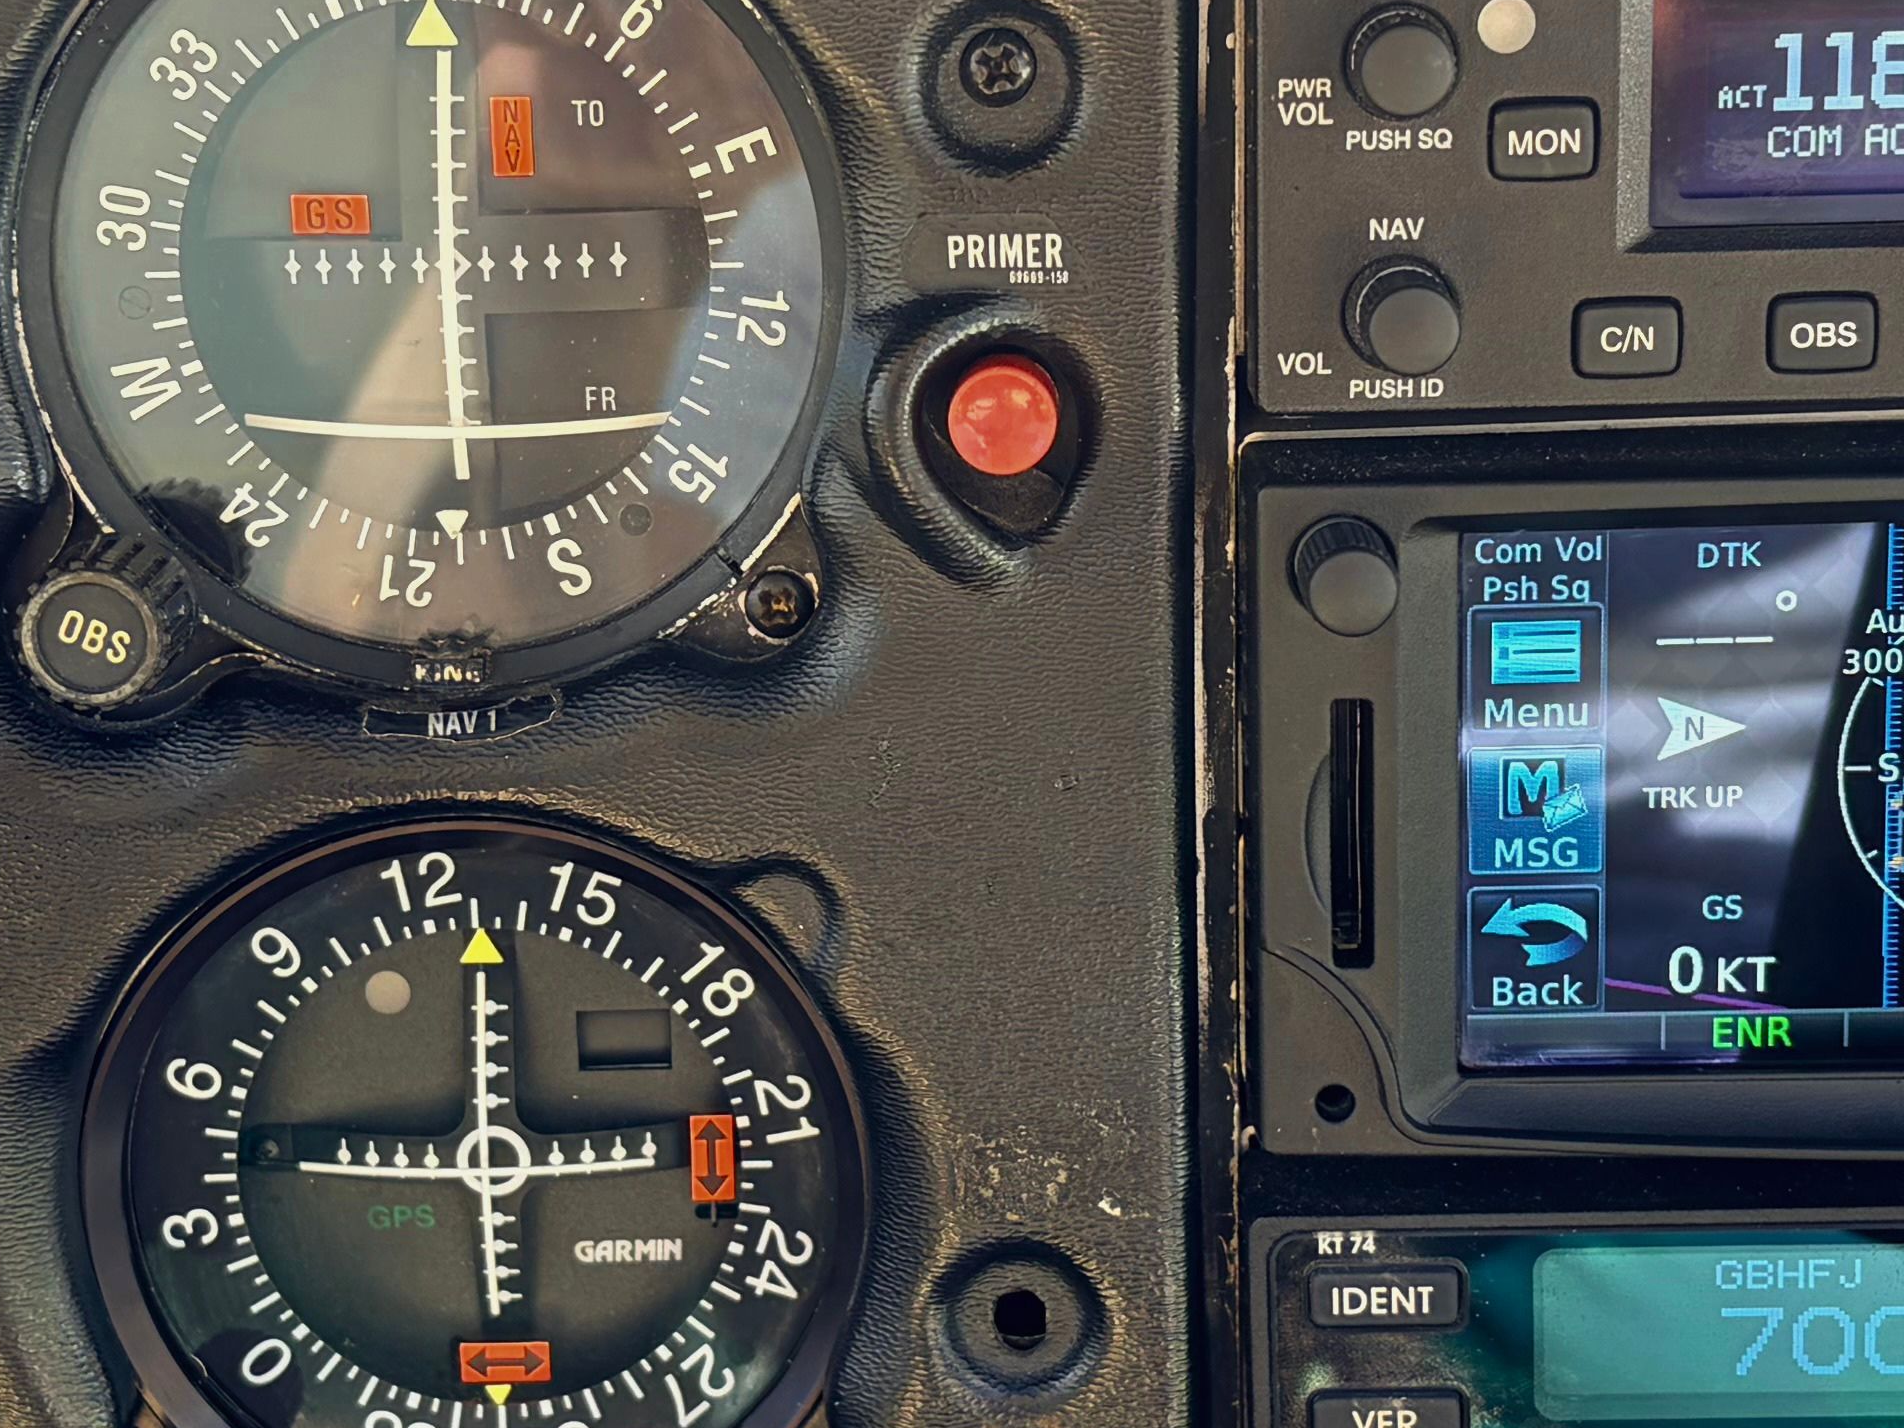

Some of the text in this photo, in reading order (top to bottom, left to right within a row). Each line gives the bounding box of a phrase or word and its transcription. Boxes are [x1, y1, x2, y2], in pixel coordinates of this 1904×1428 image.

[572, 100, 605, 128] TO
[1507, 127, 1582, 157] MON
[1767, 126, 1843, 159] COM
[947, 233, 1064, 270] PRIMER
[1790, 321, 1858, 350] OBS
[584, 386, 618, 413] FR
[1697, 541, 1762, 568] DTK
[57, 610, 132, 666] OBS
[427, 710, 498, 737] NAV 1
[1483, 697, 1590, 730] Menu
[1493, 837, 1580, 870] MSG
[381, 852, 463, 913] 12
[1492, 976, 1584, 1008] Back
[1712, 1016, 1793, 1049] ENR
[575, 1237, 684, 1265] GARMIN
[1714, 1258, 1864, 1291] GBHFJ
[1330, 1286, 1435, 1317] IDENT
